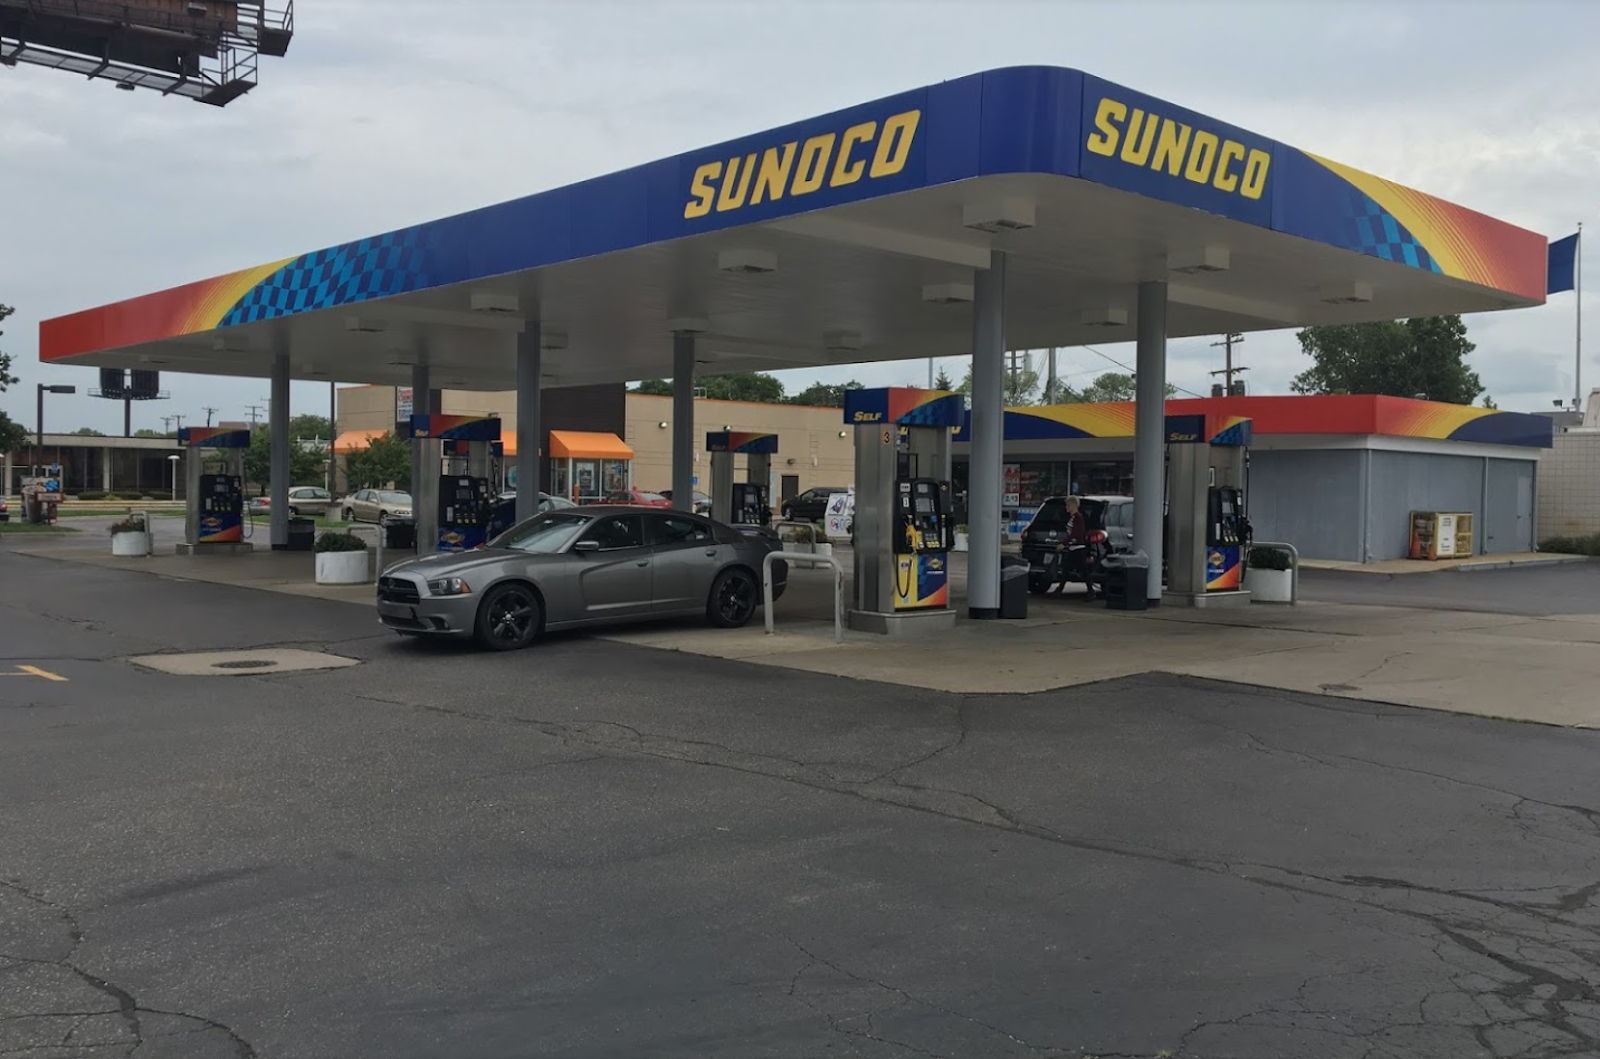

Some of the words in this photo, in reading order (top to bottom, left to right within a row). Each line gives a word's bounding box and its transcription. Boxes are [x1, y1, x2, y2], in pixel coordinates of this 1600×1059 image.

[684, 109, 921, 219] SUNOCO
[1086, 97, 1271, 200] SUNOCO
[884, 431, 890, 444] 3
